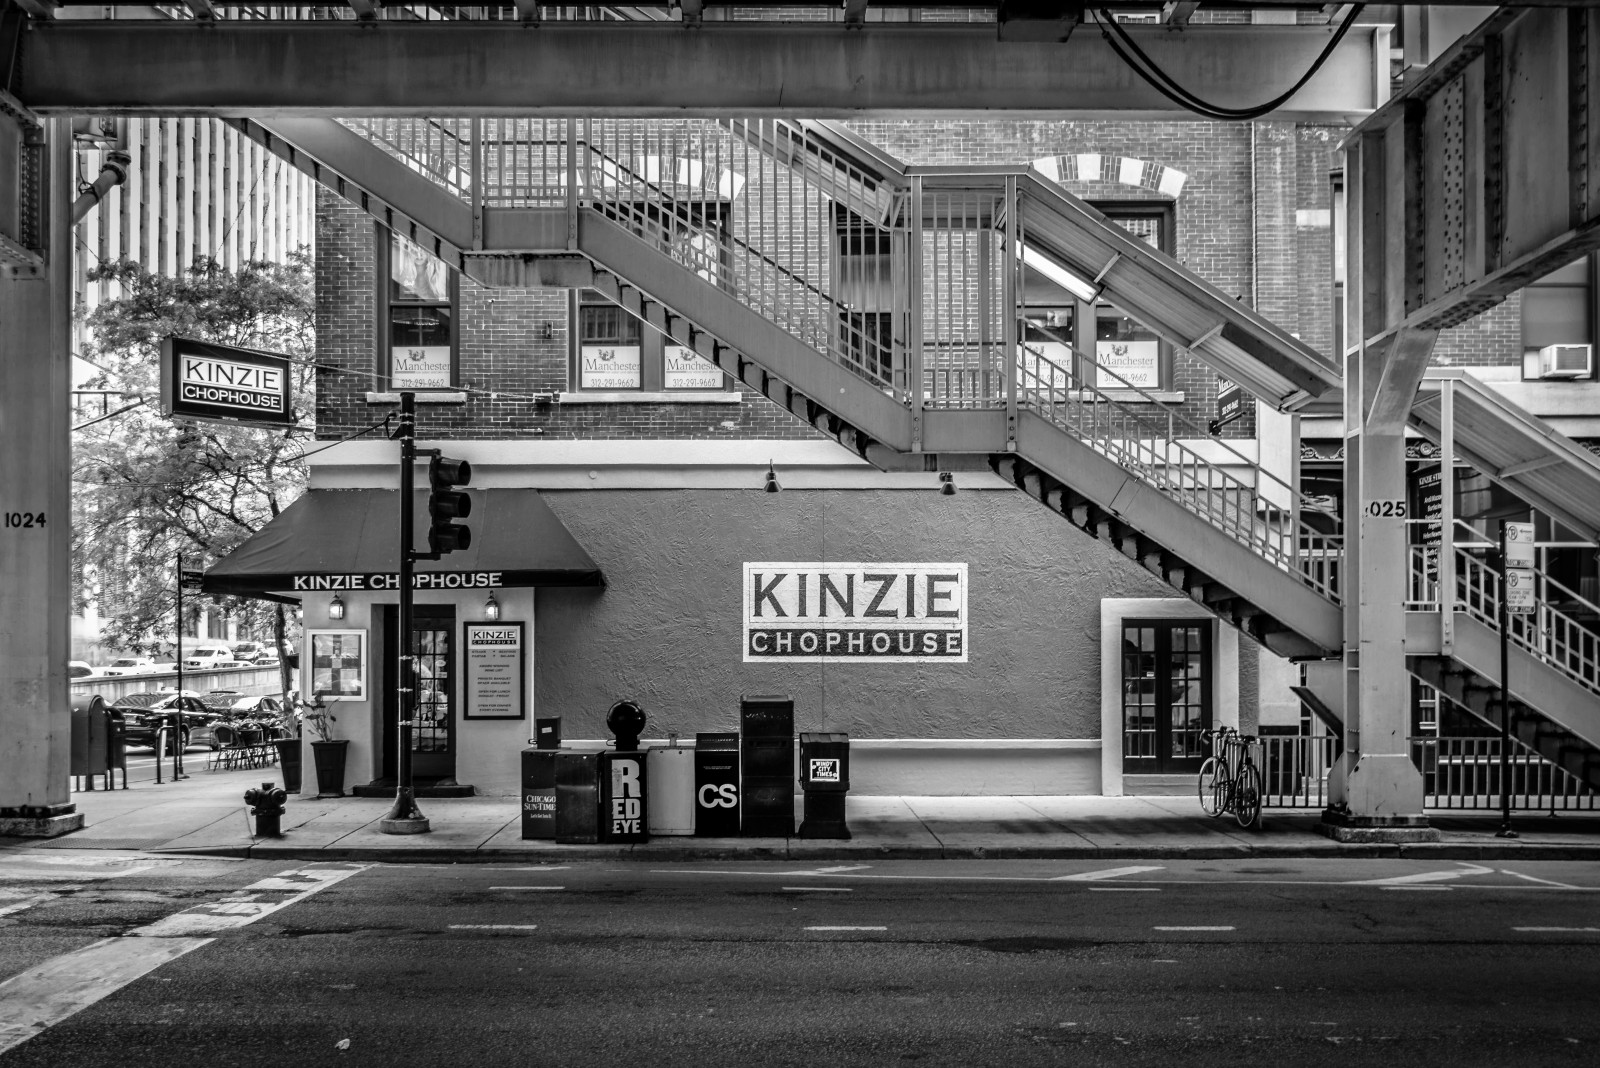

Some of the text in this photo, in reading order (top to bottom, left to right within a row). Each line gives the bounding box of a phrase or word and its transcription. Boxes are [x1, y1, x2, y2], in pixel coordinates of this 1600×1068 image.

[395, 359, 450, 371] Manchester
[584, 359, 640, 371] Manchester
[666, 359, 722, 371] Mancheste
[1100, 353, 1154, 366] Manchester
[186, 360, 279, 391] KINZIE
[590, 378, 635, 387] 312-291-9662
[672, 378, 716, 387] 312-291-9662
[184, 386, 281, 408] CHOPHOUSE
[5, 512, 47, 528] 1024
[294, 572, 503, 590] KINZIE CHPHOUSE
[752, 572, 960, 619] KINZIE
[473, 631, 516, 639] KINZIE
[751, 631, 962, 654] CHOPHOUSE
[526, 794, 557, 803] CHICAGO
[698, 783, 738, 809] CS
[523, 802, 557, 811] SUN-TIME
[611, 798, 641, 820] ED
[611, 819, 642, 834] EYE
